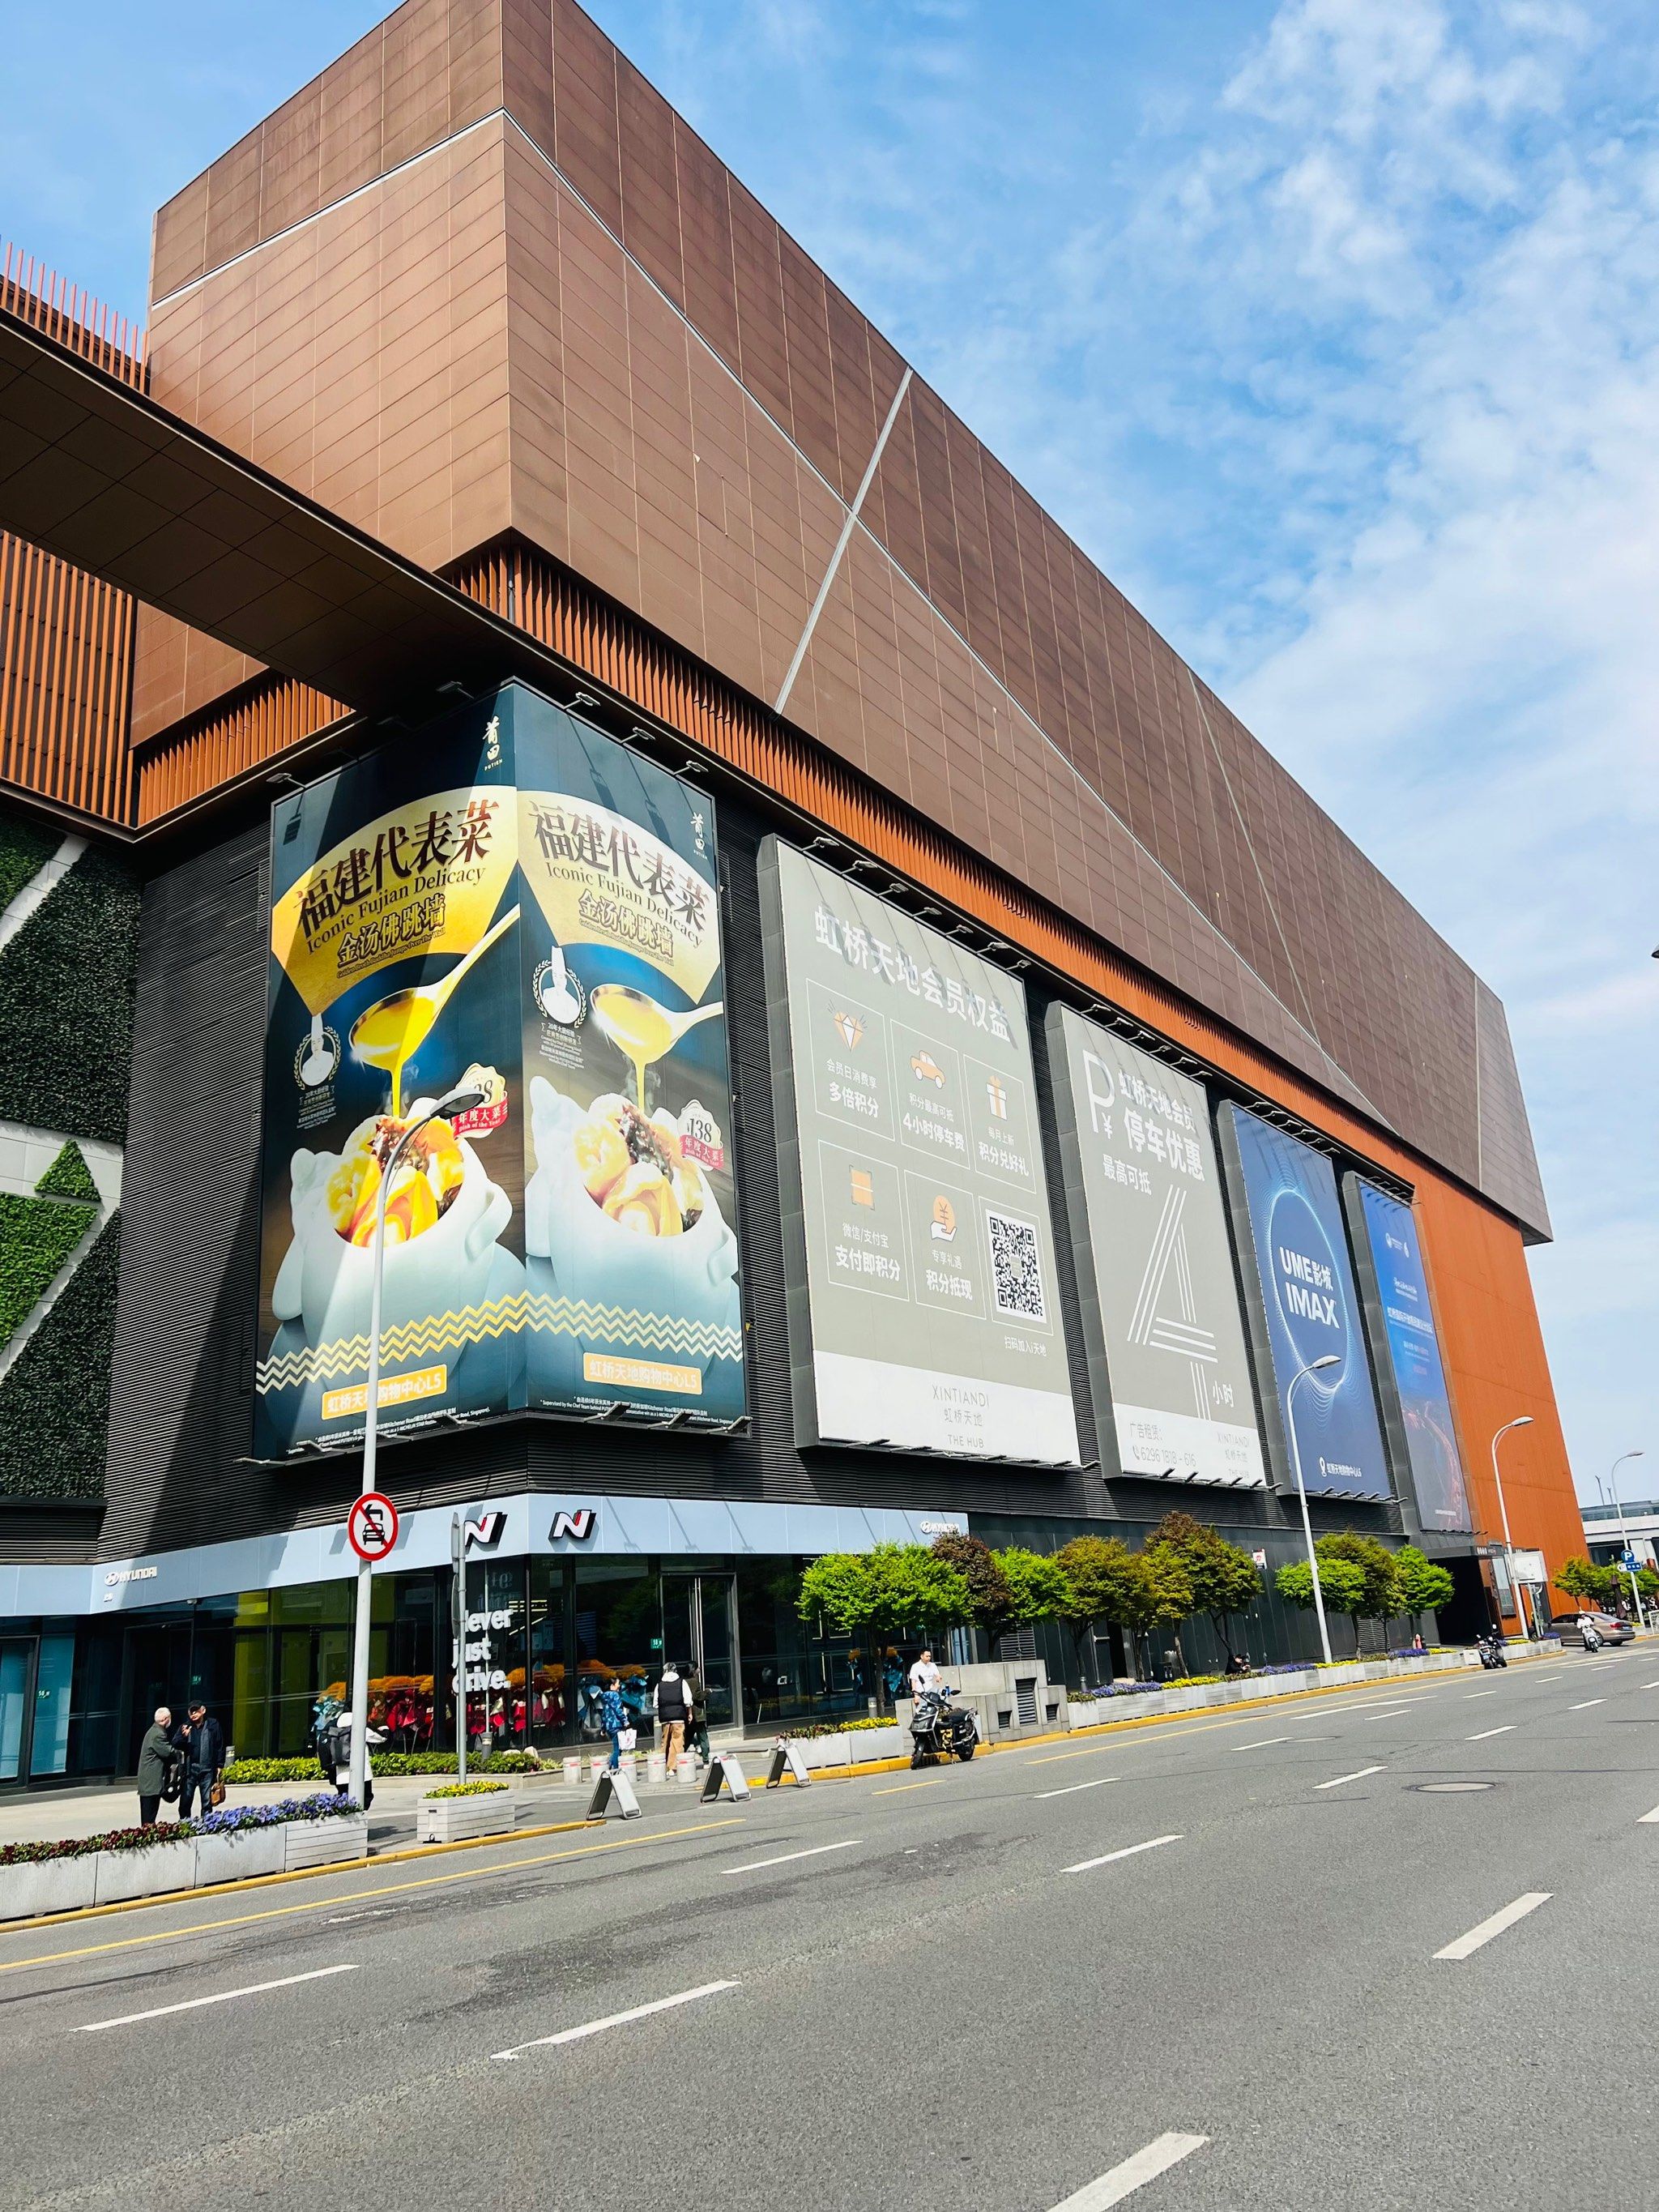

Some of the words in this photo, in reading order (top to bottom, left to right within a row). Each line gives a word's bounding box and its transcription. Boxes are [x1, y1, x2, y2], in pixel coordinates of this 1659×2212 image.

[293, 799, 499, 938] 福建代表菜
[528, 801, 710, 931] 福建代表菜
[307, 912, 355, 954] Iconic
[359, 885, 409, 917] Fujian
[414, 866, 487, 893] Delicacy
[545, 861, 593, 885] Iconic
[597, 873, 642, 905] Fujian
[647, 898, 703, 948] Delicacy
[337, 892, 446, 968] 金汤佛跳墙
[578, 888, 674, 958] 金汤佛跳墙
[814, 905, 1012, 1043] 虹桥天地会员权益
[826, 1057, 877, 1089] 会员日消费享
[458, 1105, 501, 1124] 年度大菜
[830, 1081, 879, 1118] 多倍积分
[909, 1092, 954, 1122] 积分最高可抵
[1118, 1070, 1196, 1133] 虹桥天地会员
[902, 1112, 966, 1152] 4小时停车费
[1123, 1107, 1205, 1181] 停车优惠
[979, 1142, 1030, 1176] 积分兑好礼
[1102, 1153, 1152, 1195] 最高可抵
[842, 1222, 889, 1249] 微信/支付宝
[834, 1245, 901, 1281] 支付即积分
[932, 1249, 962, 1270] 专享礼遇
[1280, 1245, 1333, 1292] UME影城
[925, 1269, 973, 1301] 积分抵现
[1285, 1281, 1340, 1329] IMAX
[327, 1372, 441, 1413] 虹桥天购物中心L5
[589, 1360, 697, 1389] 虹桥天地购物中心L5
[932, 1384, 989, 1409] XINTIANDI
[1213, 1380, 1234, 1407] 小时
[944, 1407, 983, 1427] 虹桥天地
[948, 1434, 964, 1446] THE
[967, 1437, 984, 1448] HUB
[548, 1509, 596, 1540] N
[119, 1566, 158, 1582] HYUNDAI
[1624, 1552, 1633, 1561] P
